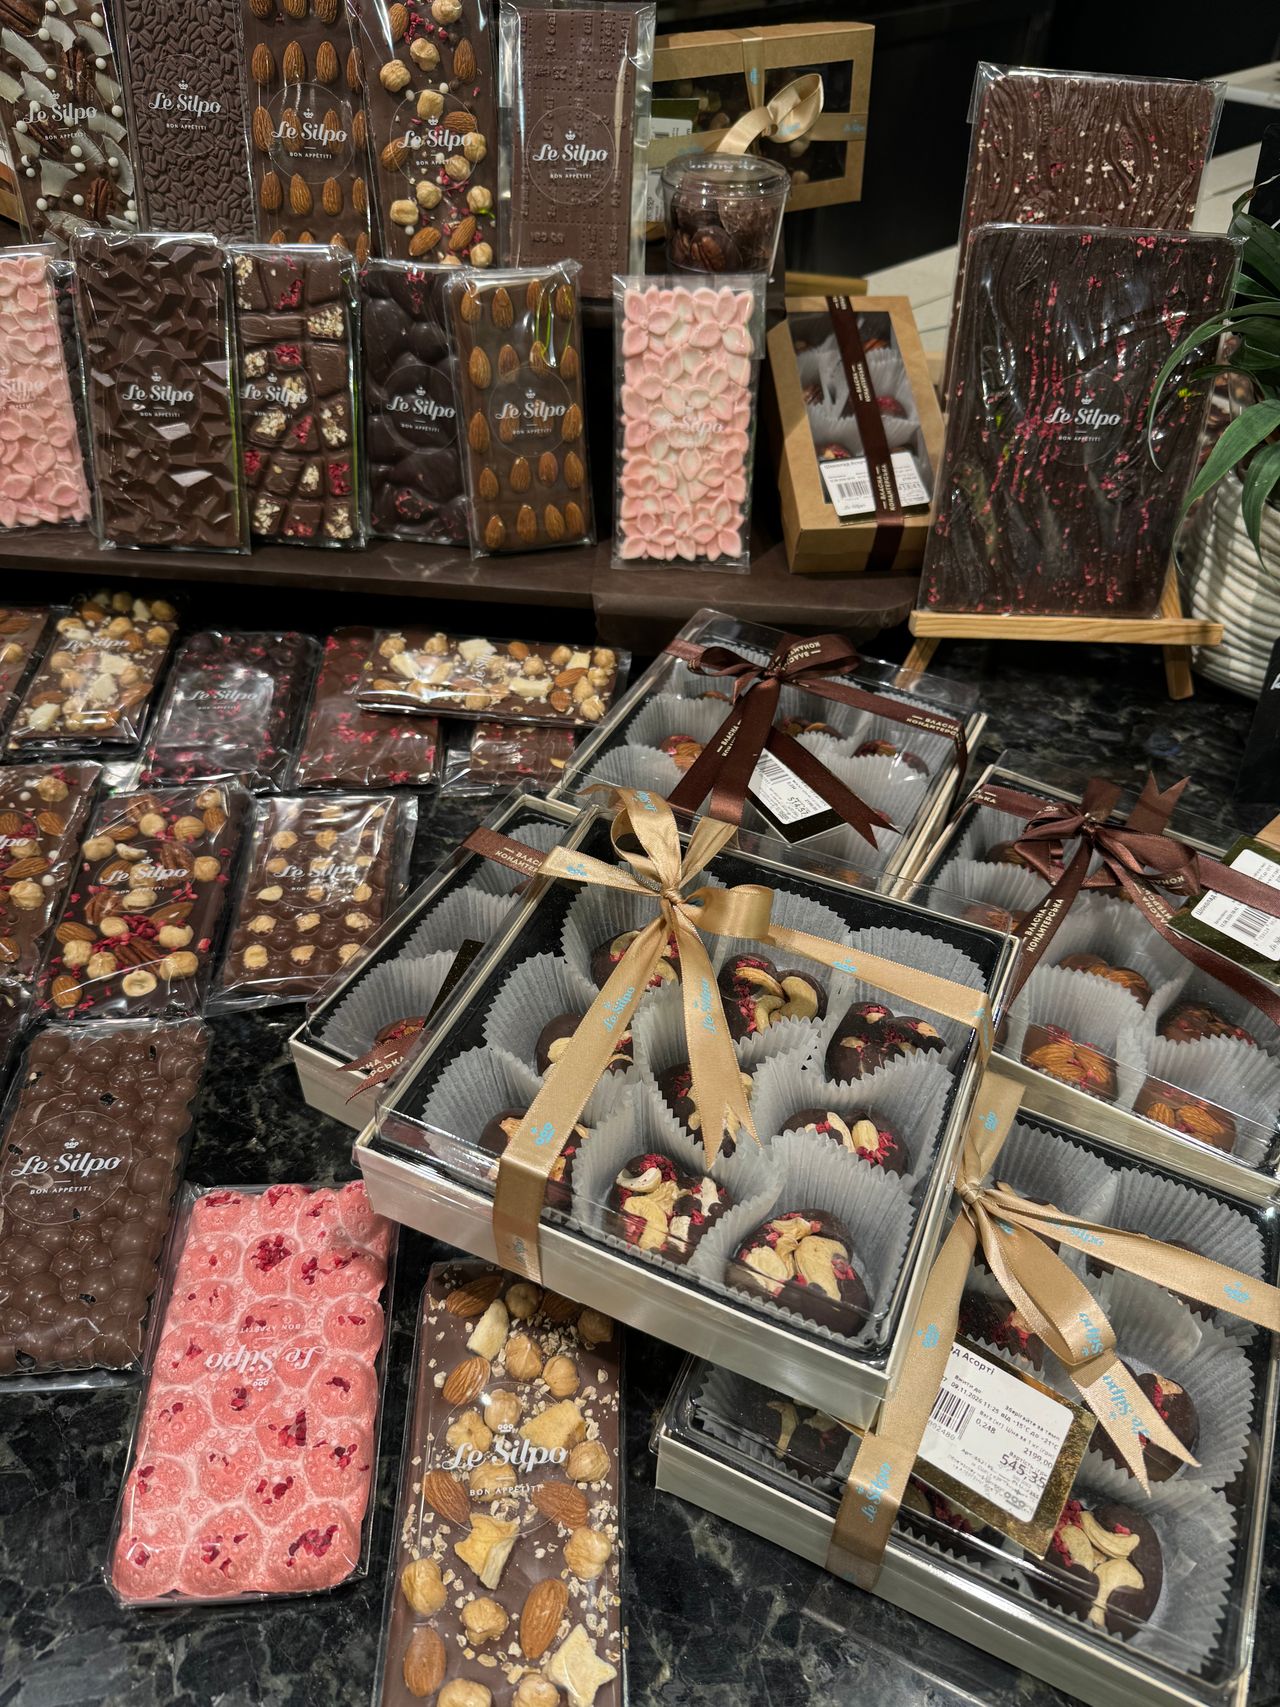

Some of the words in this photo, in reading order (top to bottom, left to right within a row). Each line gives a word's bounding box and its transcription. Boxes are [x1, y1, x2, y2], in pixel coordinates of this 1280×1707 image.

[22, 108, 46, 123] Le
[52, 103, 98, 124] Silpo
[149, 93, 174, 111] Le
[177, 93, 222, 116] Silpo
[272, 122, 298, 138] Le
[301, 122, 348, 146] Silpo
[398, 130, 422, 148] Le
[426, 130, 473, 151] Silpo
[532, 144, 560, 162] Le
[562, 144, 608, 166] Silpo
[122, 384, 147, 401] Le
[150, 385, 194, 406] Silpo
[240, 384, 262, 400] Le
[264, 385, 308, 406] Silpo
[386, 396, 411, 412] Le
[412, 398, 456, 420] Silpo
[496, 403, 522, 420] Le
[523, 401, 566, 422] Silpo
[1044, 407, 1072, 424] Le
[1074, 408, 1121, 430] Silpo
[876, 474, 888, 500] ВЛАСНА
[214, 690, 258, 702] Silpo
[720, 725, 740, 746] ВЛАСНА
[924, 718, 958, 732] ВЛАСНА
[100, 870, 130, 886] Le
[136, 865, 190, 882] Silpo
[274, 864, 305, 878] Le
[308, 863, 358, 880] Silpo
[1024, 908, 1047, 936] ВЛАСНА
[1026, 899, 1064, 952] КОНДИТЕРСЬКА
[11, 1155, 50, 1176] Le
[54, 1152, 122, 1178] Silpo
[205, 1344, 277, 1374] Silpo
[282, 1346, 326, 1370] Le
[961, 1351, 995, 1376] Асорті
[1102, 1375, 1132, 1416] Silpo
[974, 1417, 997, 1435] 0,248
[442, 1442, 486, 1470] Le
[491, 1438, 568, 1473] Silpo
[1023, 1447, 1054, 1469] 2199,00
[998, 1453, 1049, 1490] 545,35
[470, 1488, 490, 1496] BON
